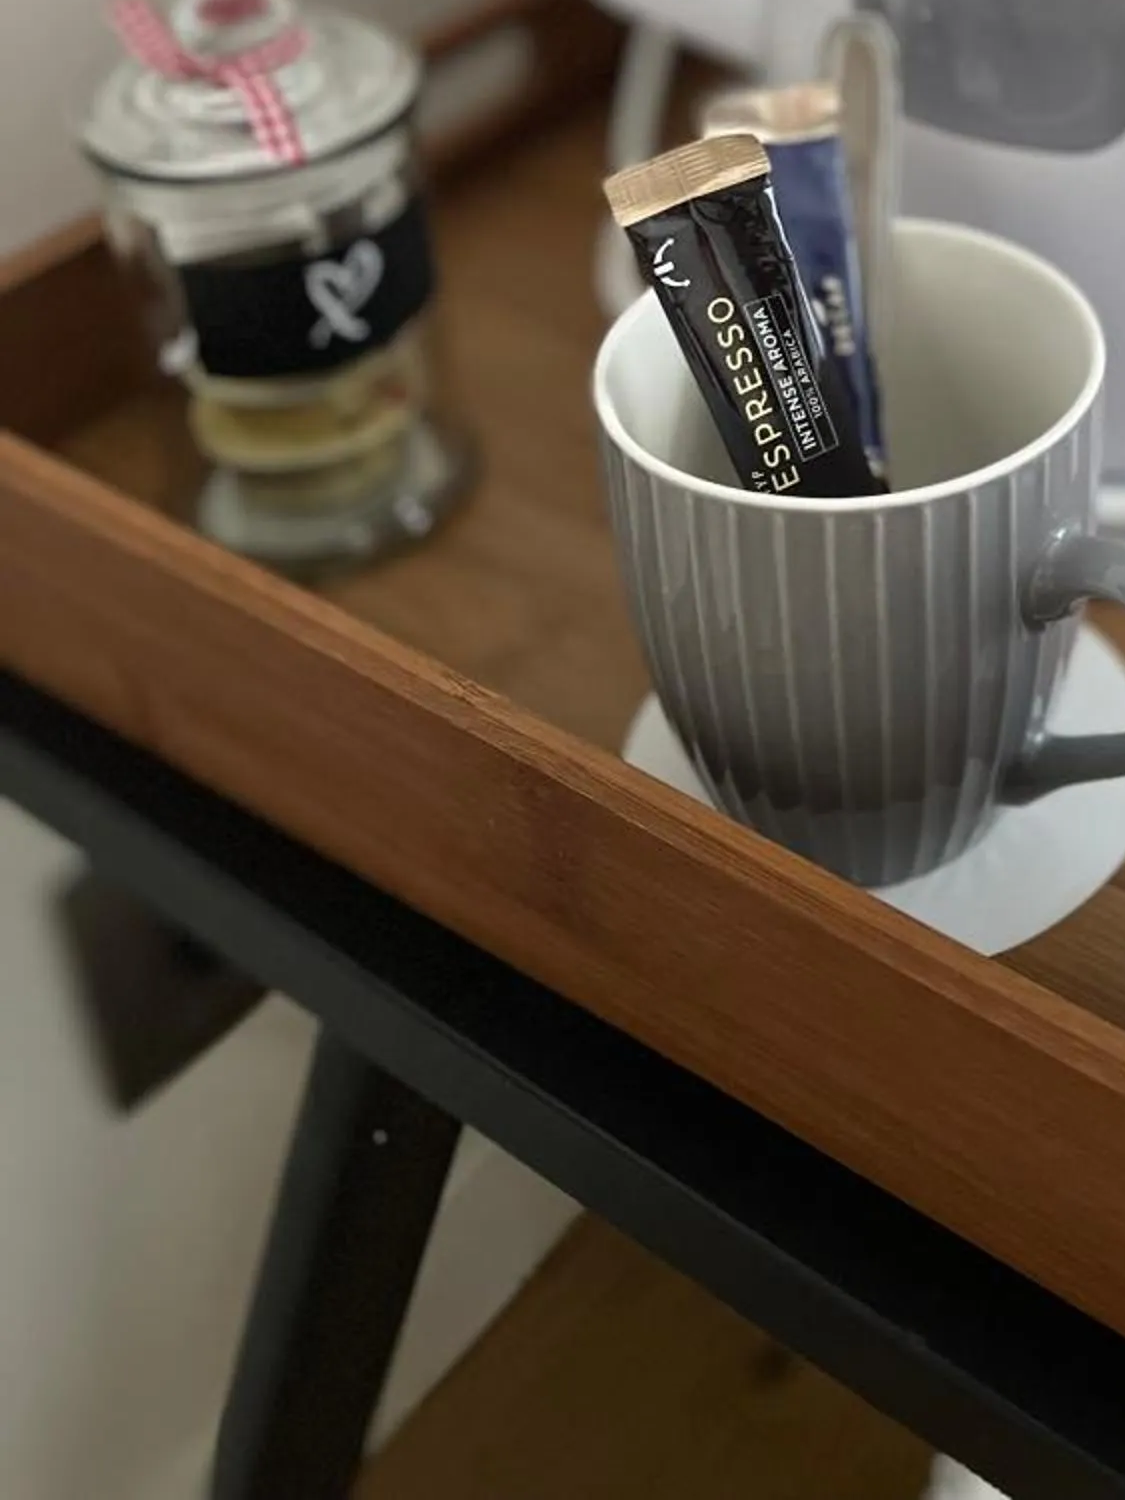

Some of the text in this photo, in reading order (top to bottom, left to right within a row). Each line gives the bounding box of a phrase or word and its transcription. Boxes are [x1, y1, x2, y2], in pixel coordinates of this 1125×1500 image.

[707, 296, 801, 491] ESPRESSO
[753, 306, 817, 451] INTENSE AROMA
[783, 329, 811, 384] ARABICA
